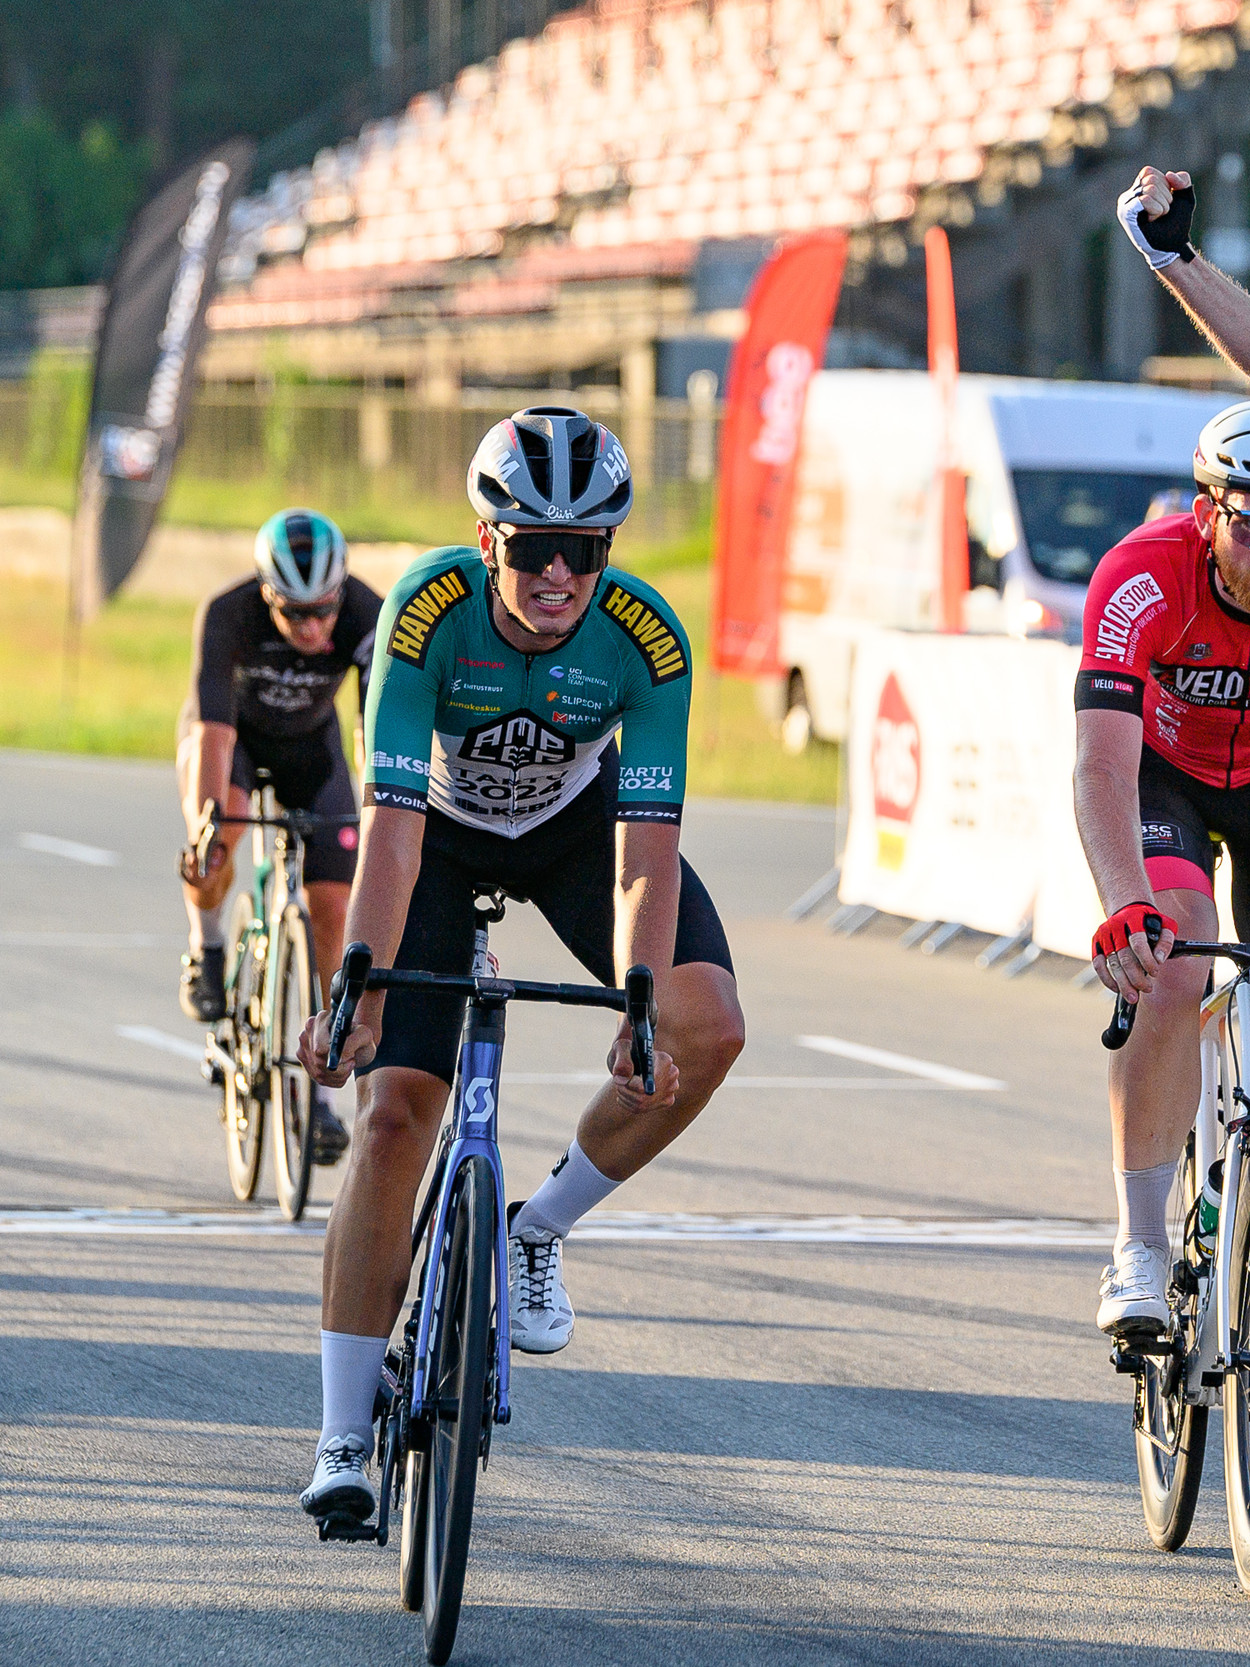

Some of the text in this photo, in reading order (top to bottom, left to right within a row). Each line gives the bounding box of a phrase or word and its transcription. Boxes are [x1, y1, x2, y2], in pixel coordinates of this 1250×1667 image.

[1119, 578, 1159, 612] STORE
[392, 572, 465, 660] HAWAII
[605, 587, 684, 677] HAWAII
[568, 674, 608, 687] CONTINENTAL
[562, 695, 601, 710] SLIPSON
[619, 767, 672, 777] TARTU
[455, 779, 565, 800] 2024
[618, 778, 672, 791] 2024
